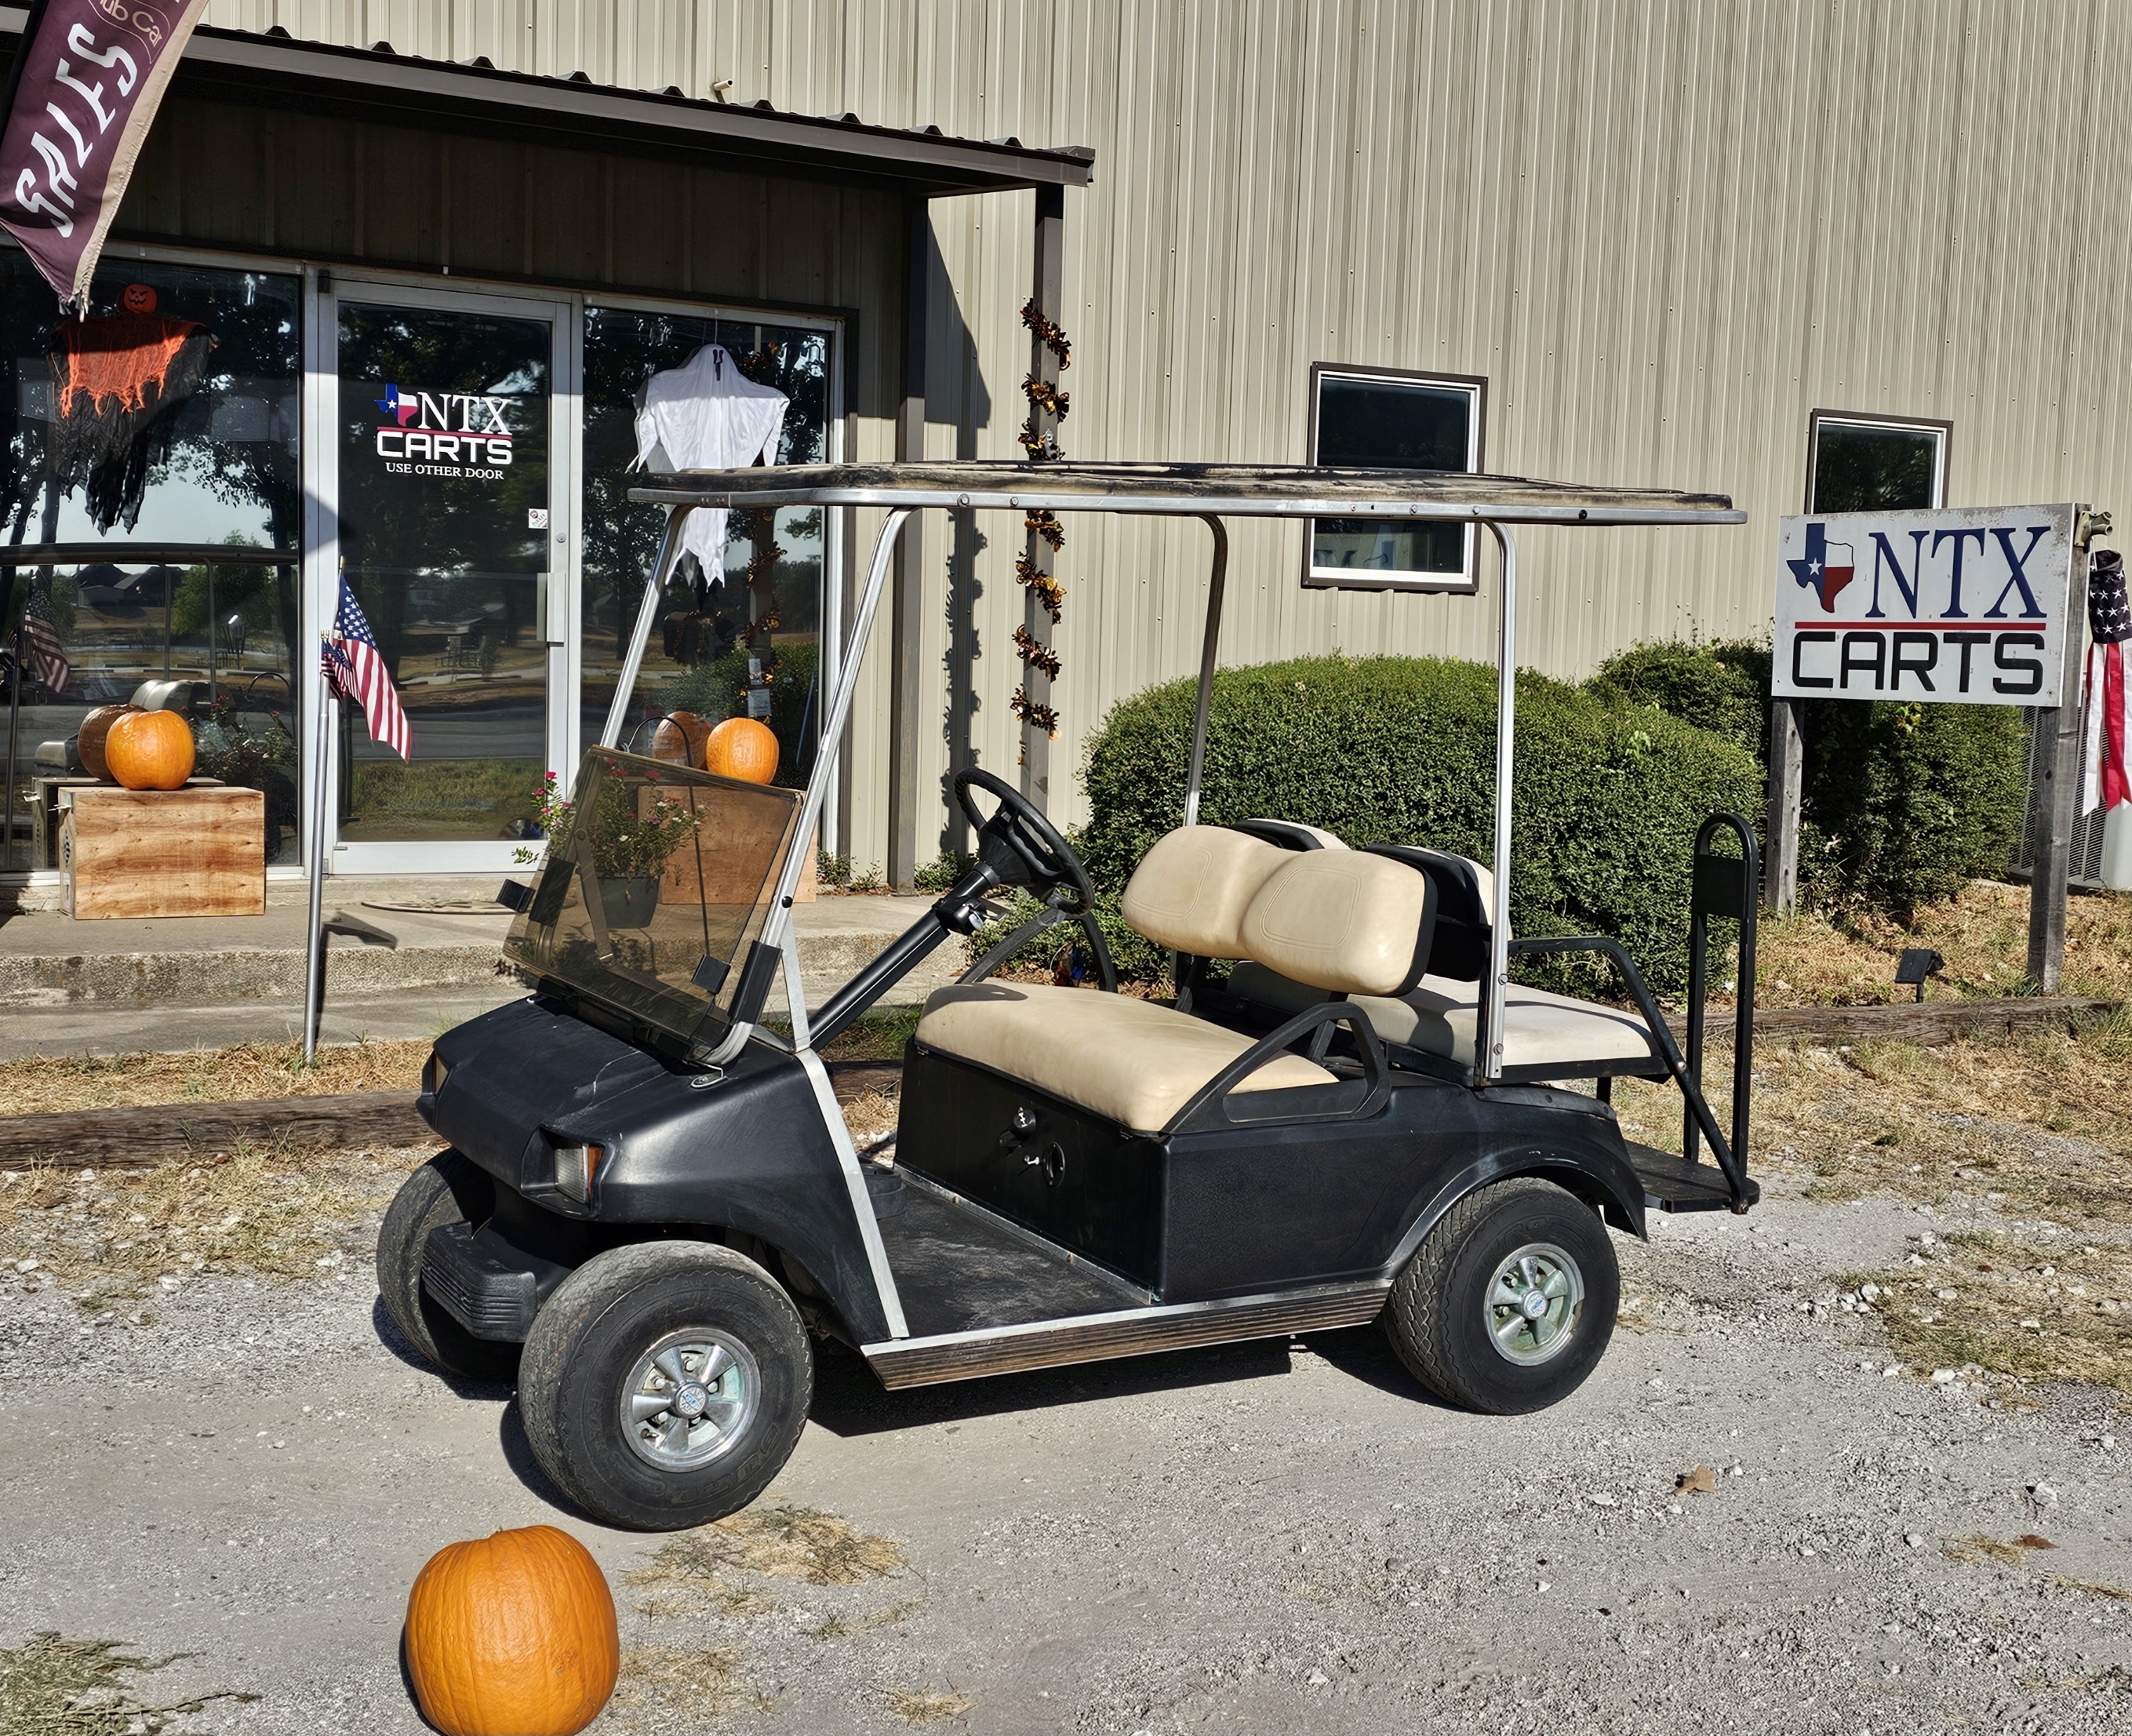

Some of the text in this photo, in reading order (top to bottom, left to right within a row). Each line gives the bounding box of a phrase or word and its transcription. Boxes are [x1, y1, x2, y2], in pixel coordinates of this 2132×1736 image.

[132, 10, 163, 48] Car
[15, 23, 138, 238] SALES
[417, 391, 513, 436] NTX
[377, 430, 513, 465] CARTS
[385, 461, 504, 480] USE OTHER DOOR
[1865, 526, 2051, 619] NTX
[1792, 631, 2046, 695] CARTS
